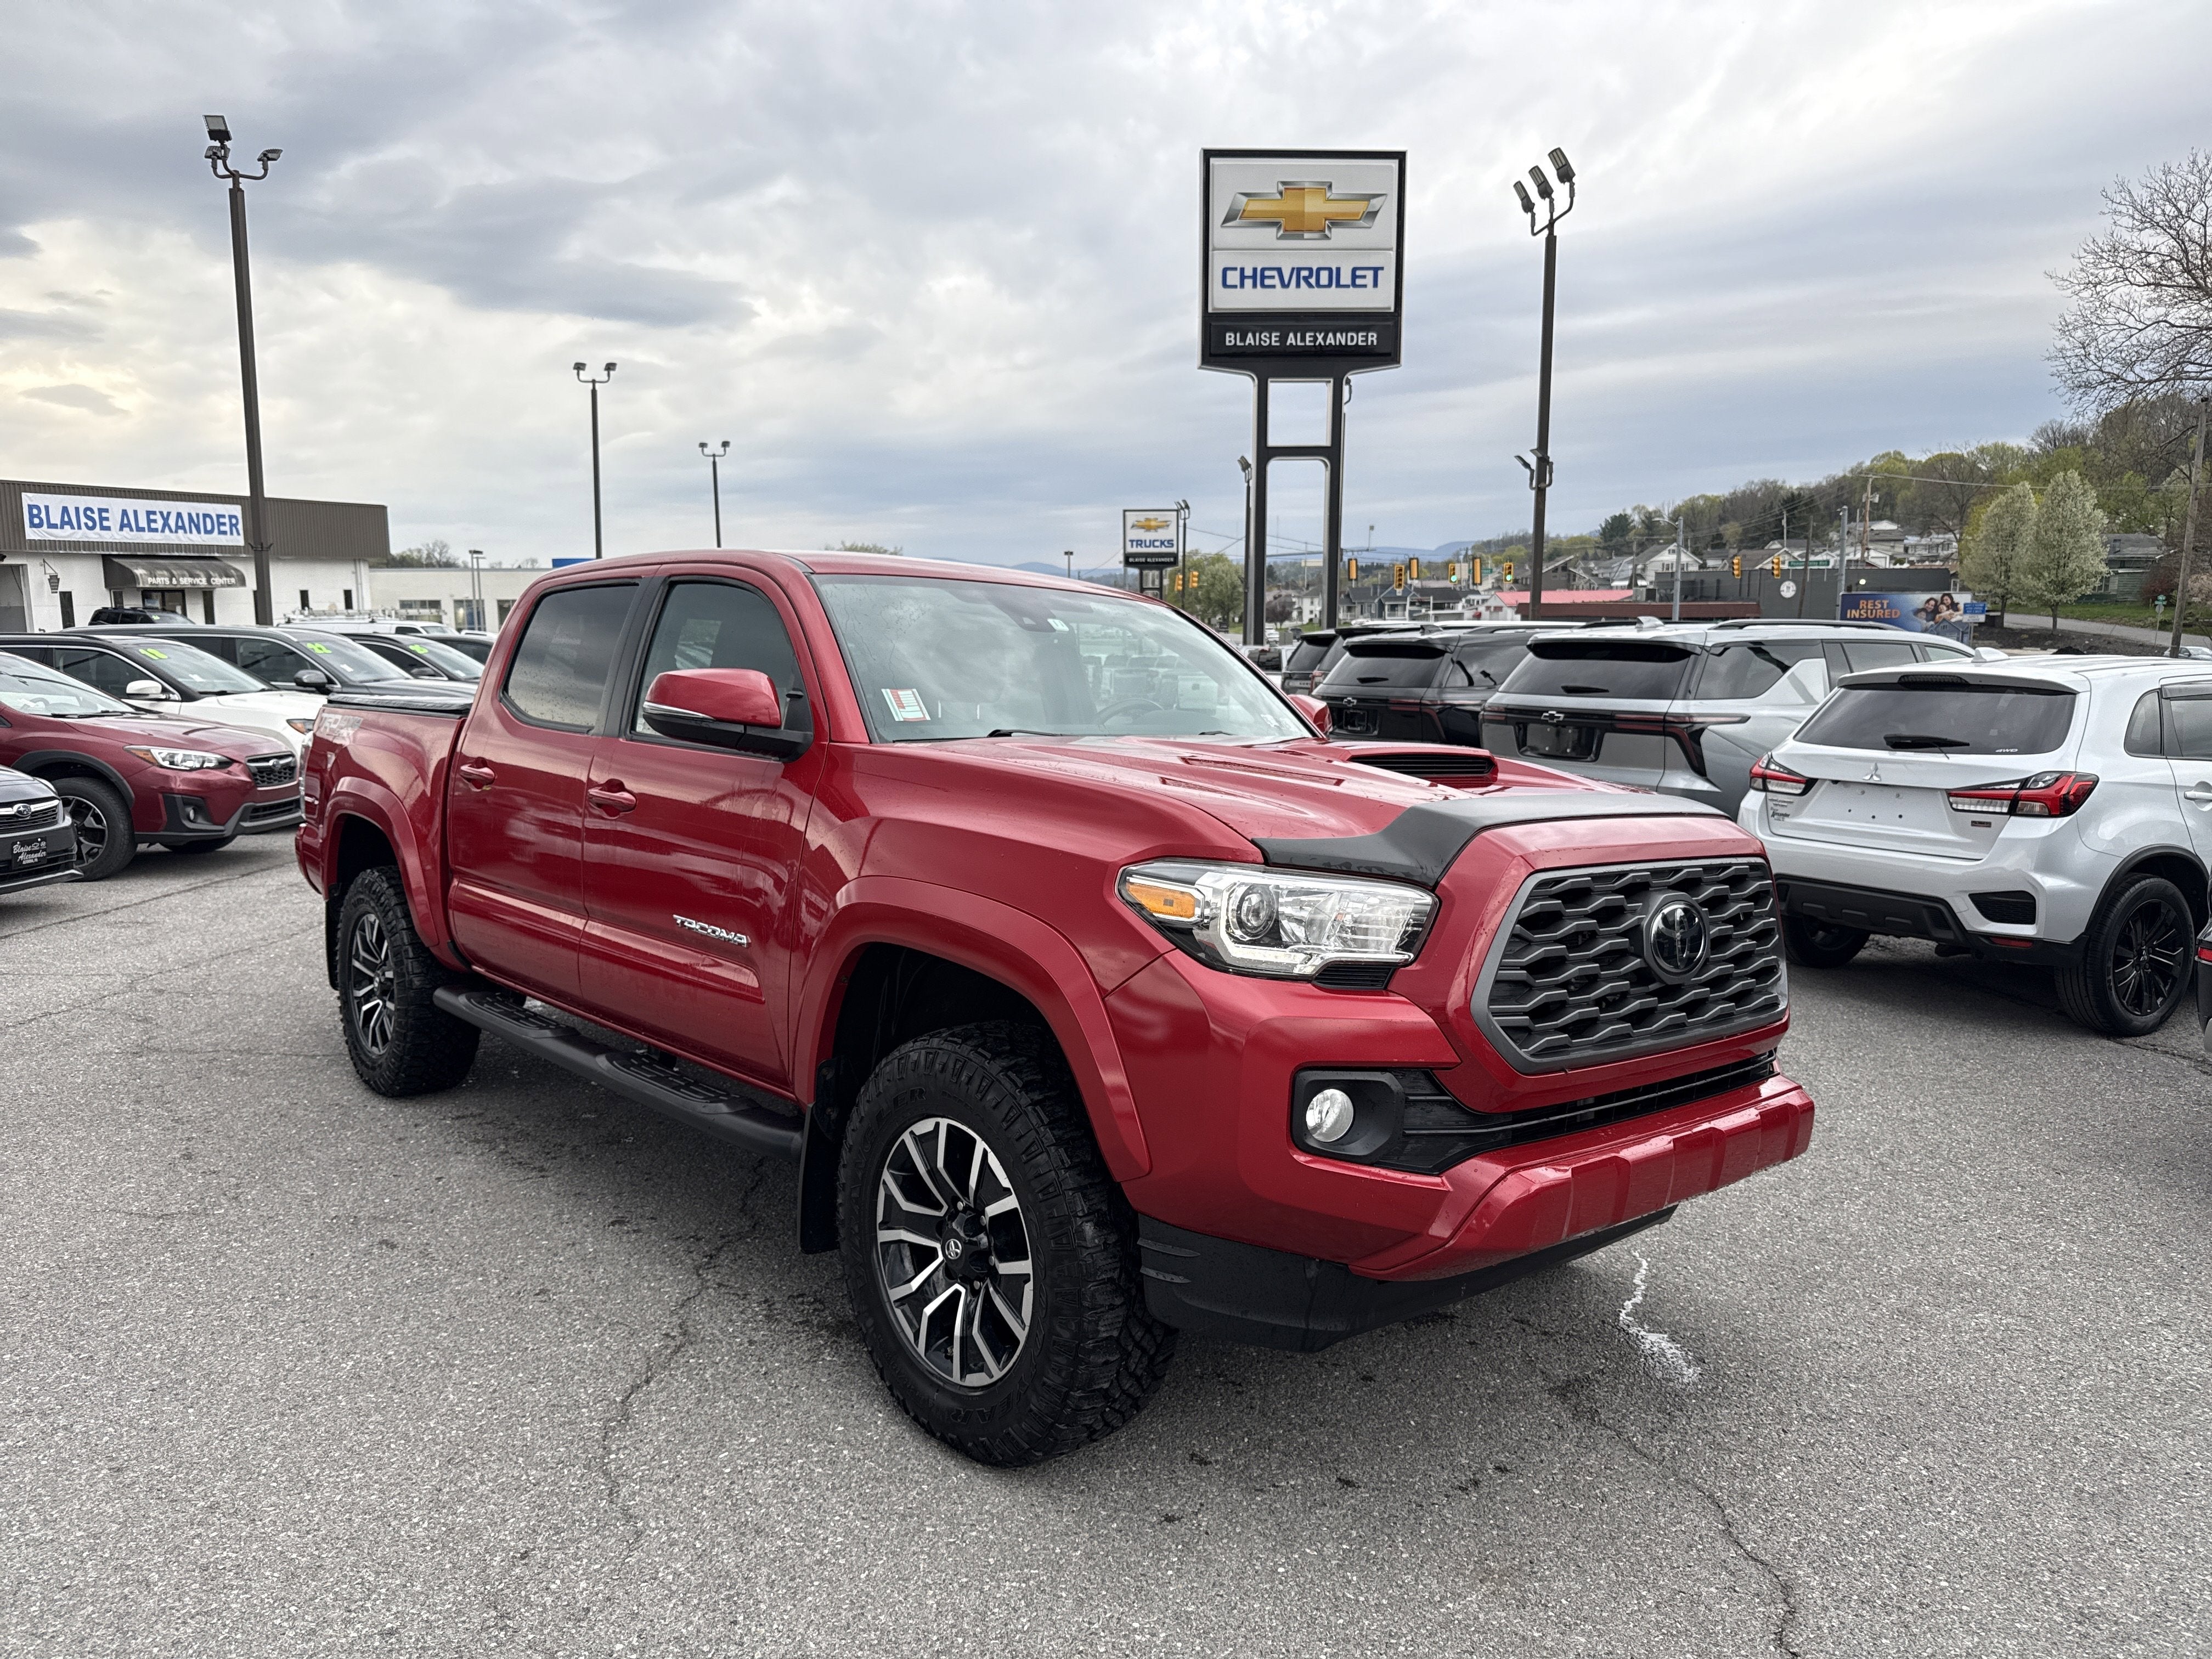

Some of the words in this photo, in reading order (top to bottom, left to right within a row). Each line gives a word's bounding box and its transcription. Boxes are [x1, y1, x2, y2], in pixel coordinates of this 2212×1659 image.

[1222, 267, 1384, 289] CHEVROLET
[1226, 332, 1280, 346] BLAISE
[1286, 332, 1378, 346] ALEXANDER
[27, 504, 111, 531] BLAISE
[119, 509, 241, 536] ALEXANDER
[1128, 539, 1174, 548] TRUCKS
[1859, 600, 1889, 609] REST
[1847, 609, 1900, 619] INSURED
[13, 844, 32, 854] Blaise
[17, 850, 46, 862] Alexander
[673, 914, 749, 948] TACOMA
